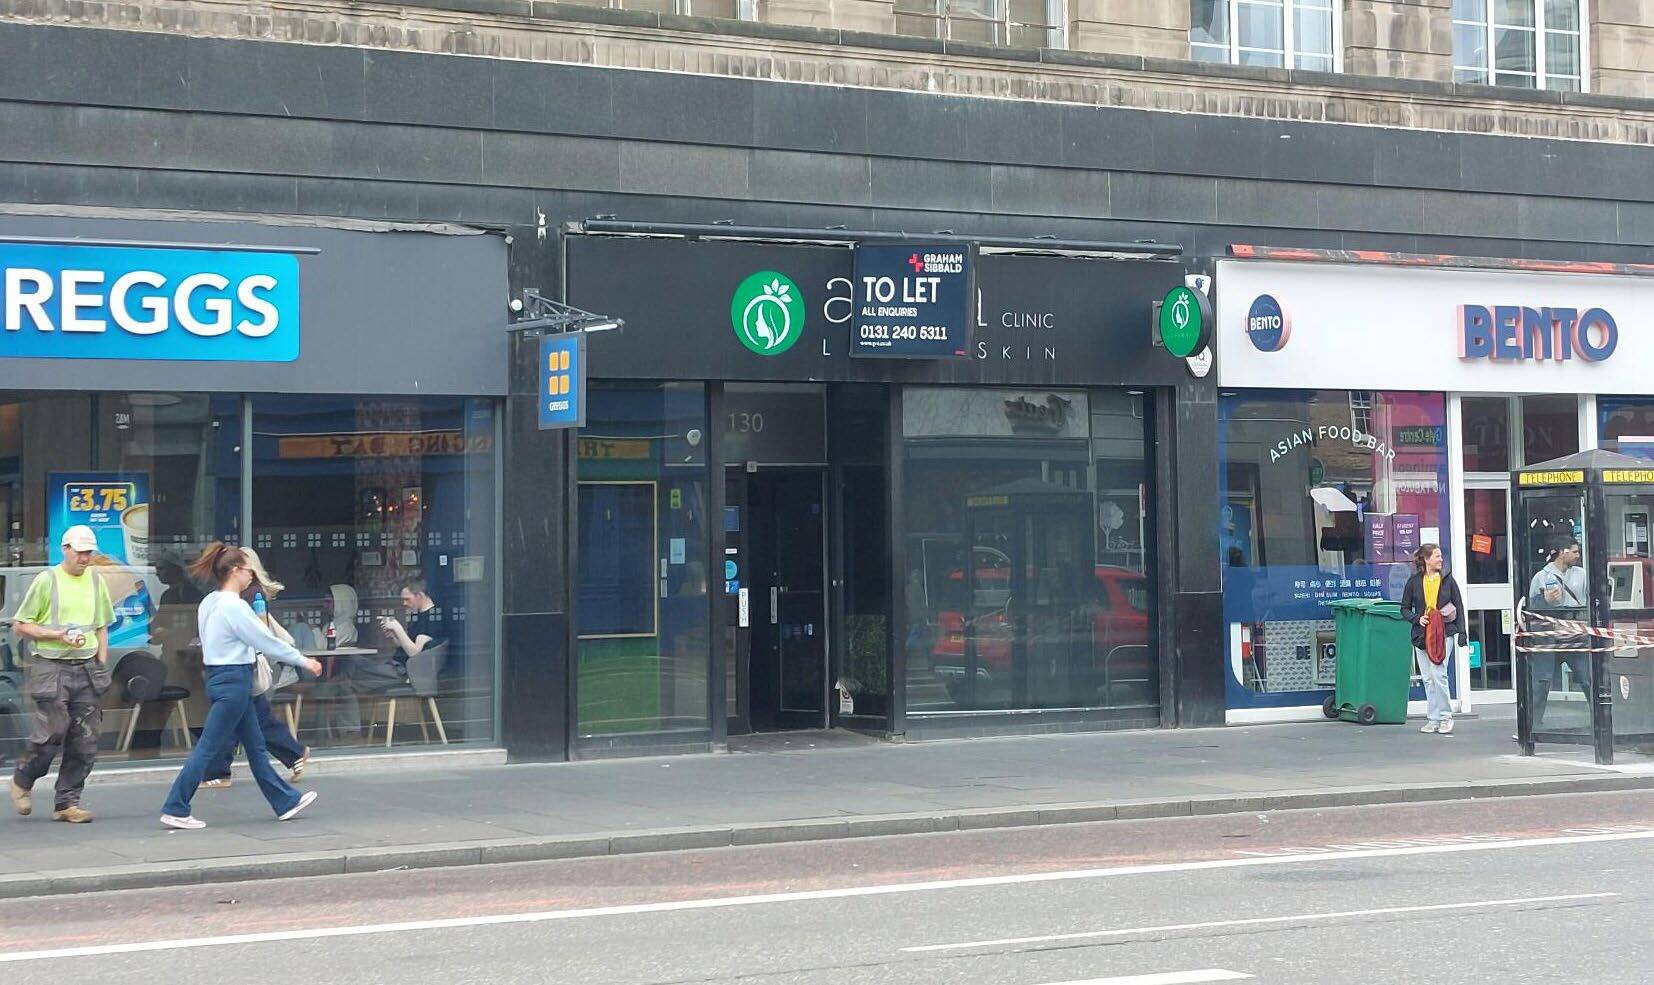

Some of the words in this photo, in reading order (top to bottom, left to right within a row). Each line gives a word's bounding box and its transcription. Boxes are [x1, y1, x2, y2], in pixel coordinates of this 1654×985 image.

[924, 254, 963, 264] GRAHAM
[924, 264, 963, 273] SIBBALD
[863, 276, 895, 303] TO
[903, 277, 941, 303] LET
[862, 307, 876, 317] ALL
[878, 307, 918, 317] ENQUIRIES
[1001, 312, 1054, 328] CLINIC
[1250, 315, 1281, 330] BENTO
[860, 325, 890, 339] 0131
[892, 326, 917, 340] 240
[920, 326, 948, 340] 5311
[1456, 304, 1619, 361] BENTO
[729, 413, 763, 432] 130
[1269, 428, 1313, 464] ASIAN
[1318, 425, 1362, 442] FOOD
[1367, 435, 1396, 463] BAR
[1526, 472, 1576, 483] TELEPHONE
[70, 488, 127, 512] £3.75
[740, 591, 748, 626] PUSH
